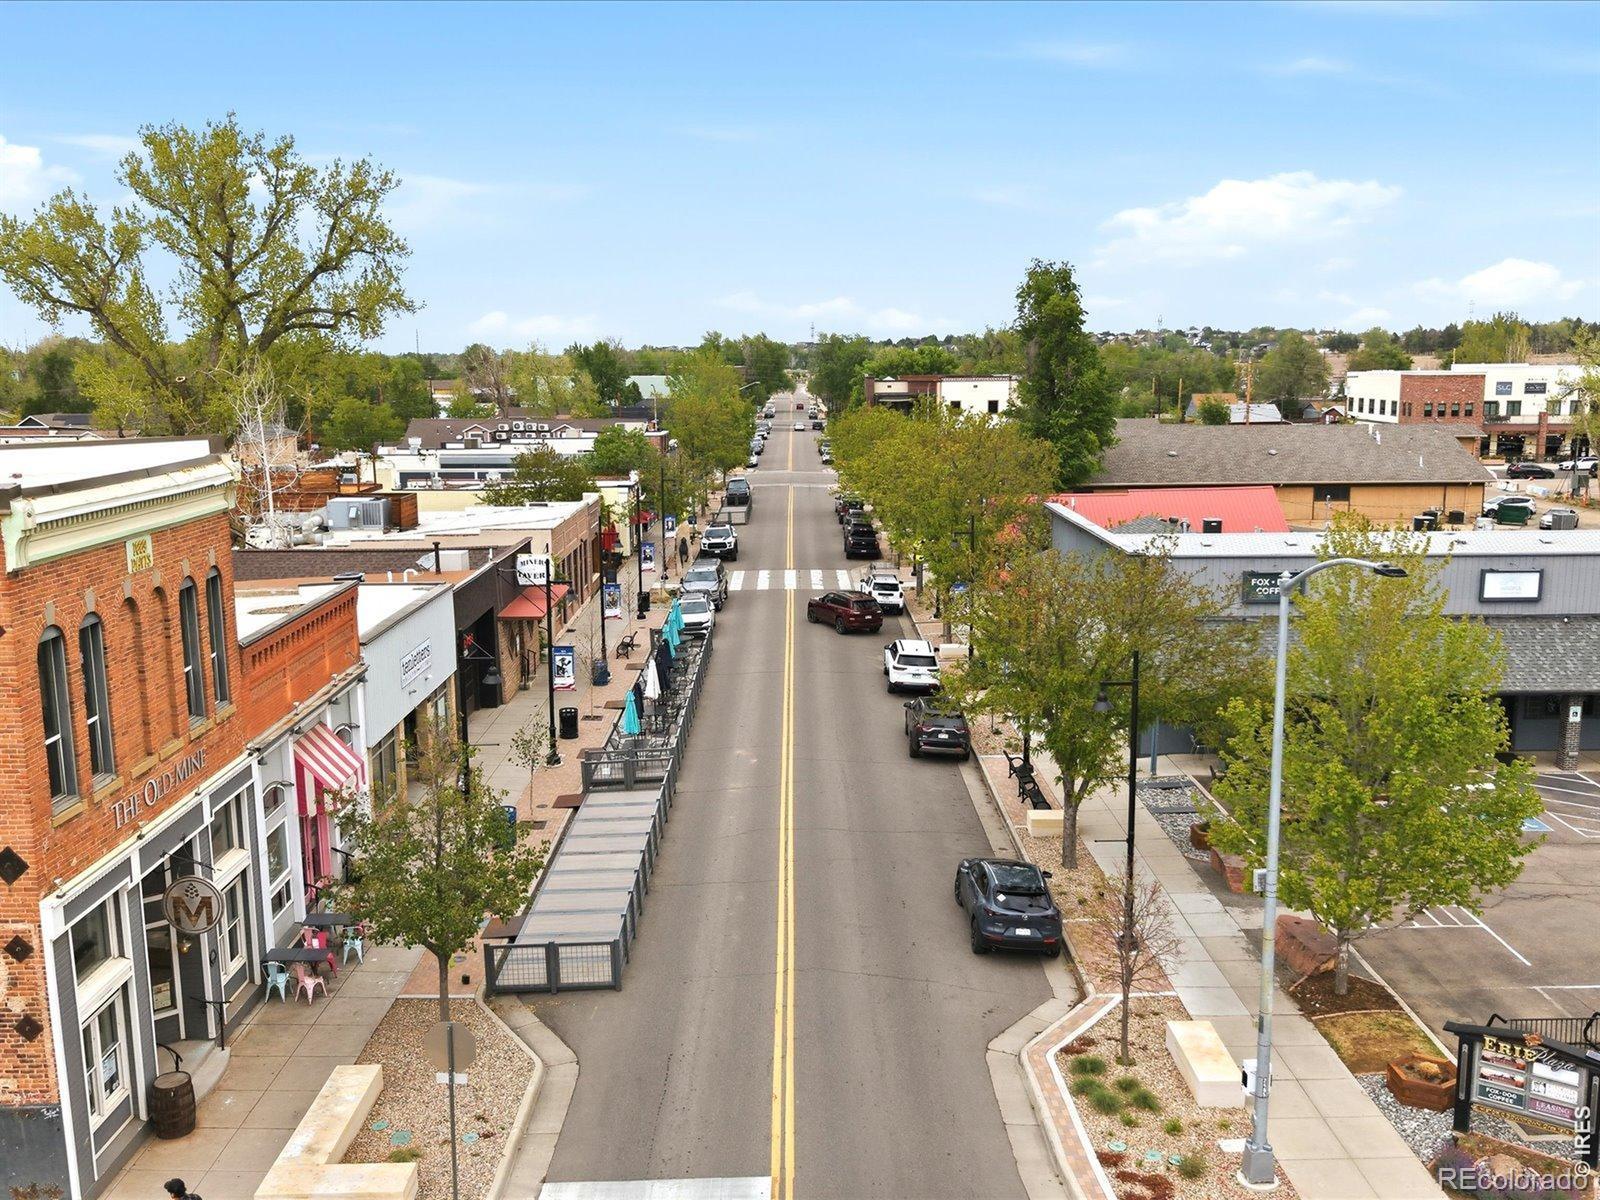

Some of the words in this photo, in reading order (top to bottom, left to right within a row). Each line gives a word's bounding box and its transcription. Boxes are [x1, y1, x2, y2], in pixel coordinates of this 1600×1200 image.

[1251, 578, 1270, 586] FOX
[1256, 587, 1281, 595] COFF
[110, 793, 142, 829] THE
[175, 748, 206, 786] MINE
[1482, 1035, 1537, 1061] ERIE
